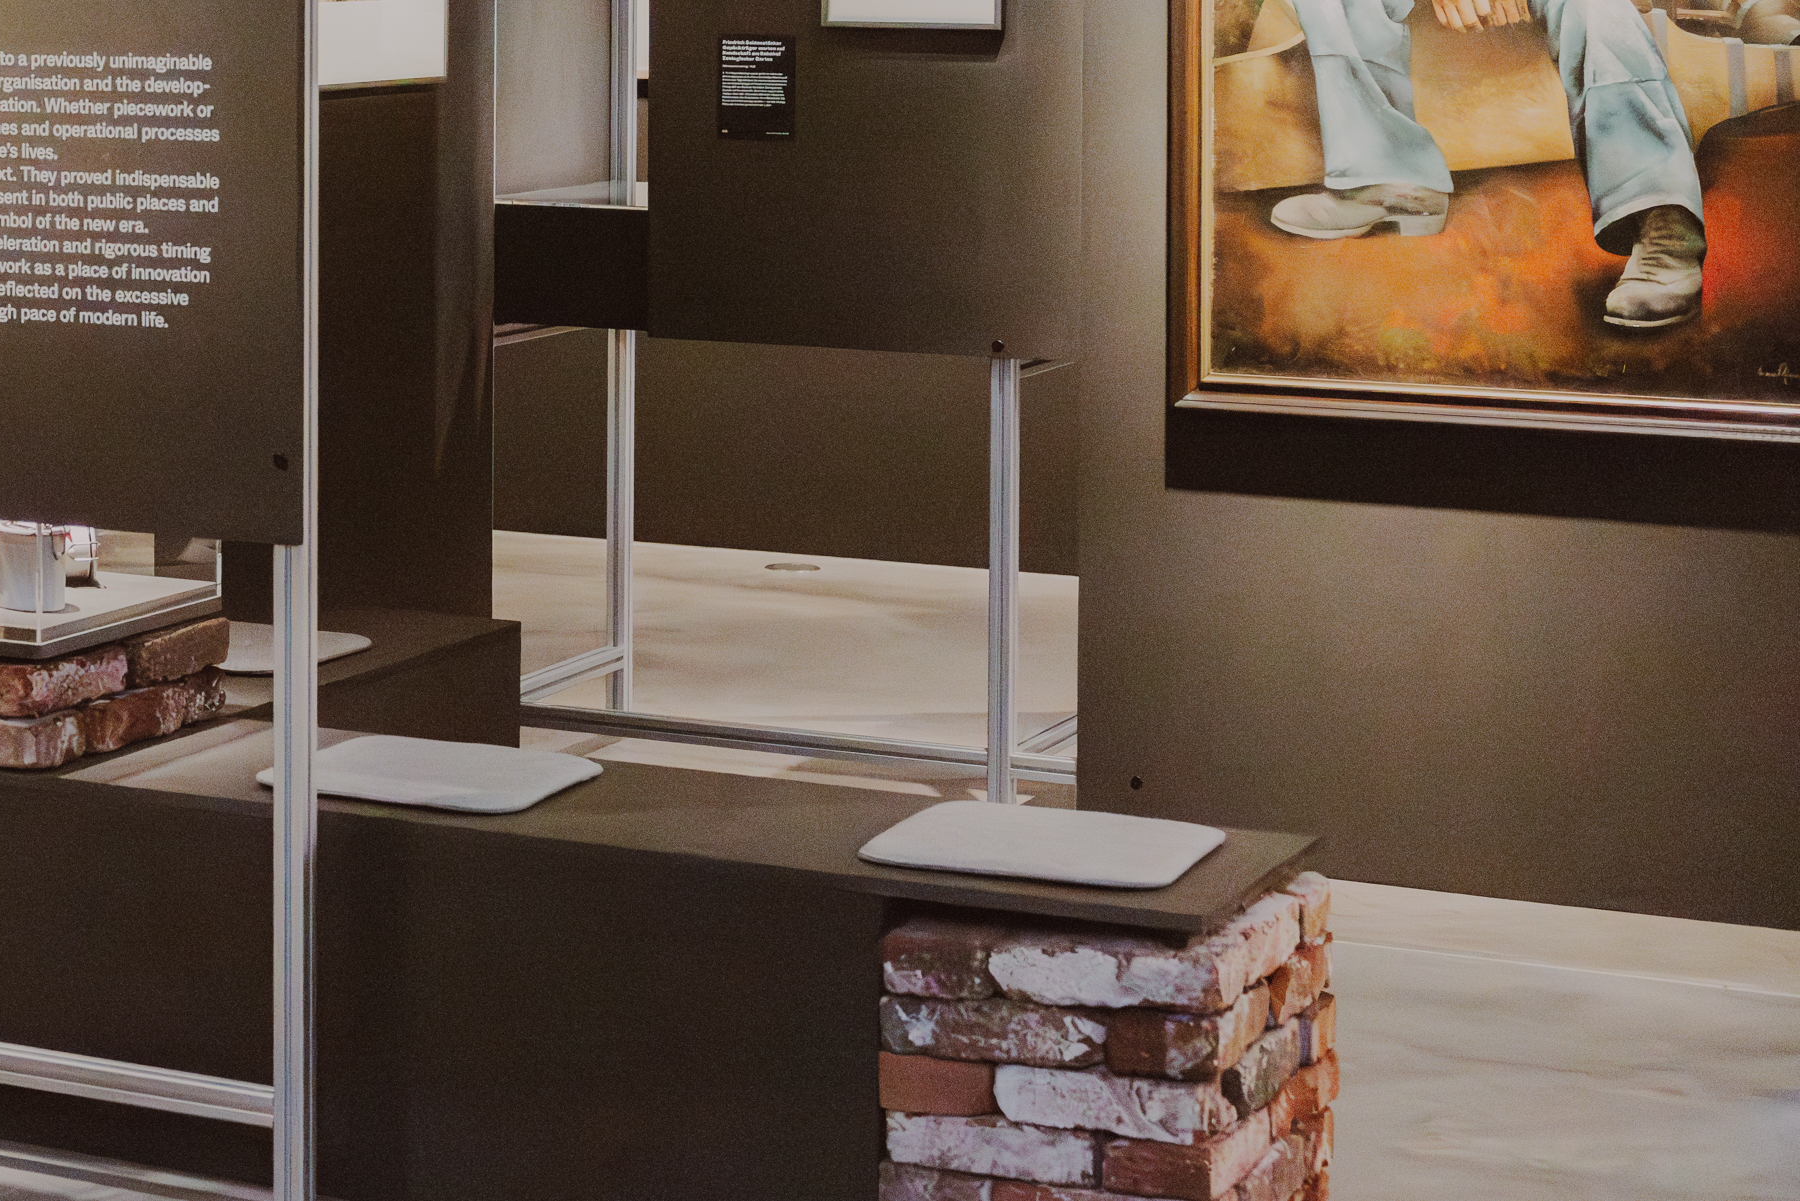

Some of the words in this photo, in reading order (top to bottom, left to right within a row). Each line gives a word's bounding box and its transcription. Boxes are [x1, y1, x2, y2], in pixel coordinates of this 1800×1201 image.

[18, 53, 28, 66] a
[31, 51, 106, 72] previously
[110, 52, 212, 73] unimaginable
[84, 76, 111, 91] and
[116, 76, 141, 92] the
[145, 76, 210, 98] develop-
[44, 97, 110, 114] Whether
[114, 99, 193, 118] piecework
[197, 105, 214, 117] or
[22, 121, 49, 136] and
[53, 122, 137, 141] operational
[142, 127, 220, 143] processes
[22, 143, 58, 160] lives.
[21, 308, 56, 324] pace
[59, 307, 76, 323] of
[79, 310, 137, 326] modern
[142, 311, 168, 328] life.
